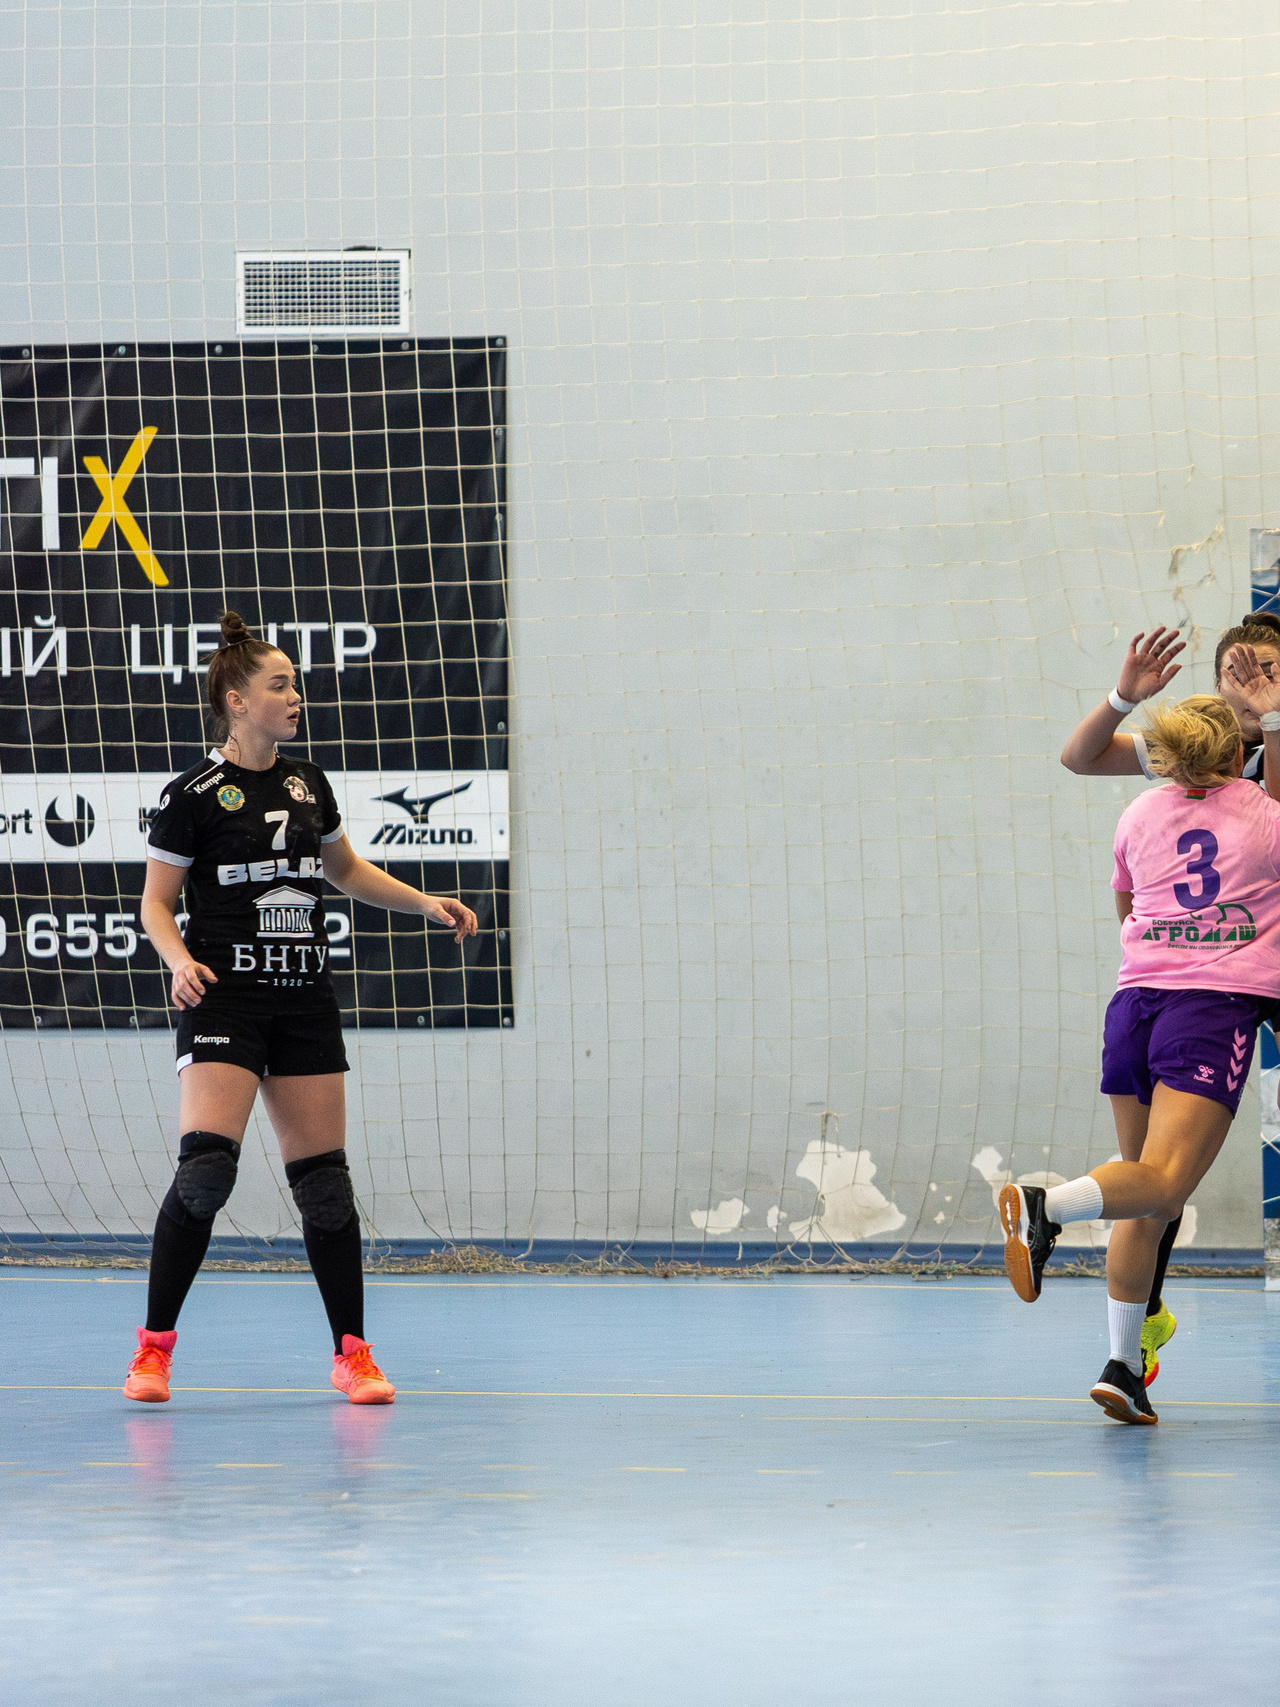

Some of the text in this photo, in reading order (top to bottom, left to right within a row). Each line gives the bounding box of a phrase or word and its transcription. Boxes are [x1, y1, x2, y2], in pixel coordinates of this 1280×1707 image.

[131, 622, 377, 684] ЦЕТР
[193, 772, 225, 795] Kempa
[264, 810, 289, 850] 7
[1173, 829, 1220, 909] 3
[1140, 925, 1257, 942] АГРОМАШ
[232, 944, 328, 973] БНТУ
[273, 978, 302, 987] 1920
[194, 1034, 230, 1046] Kempa
